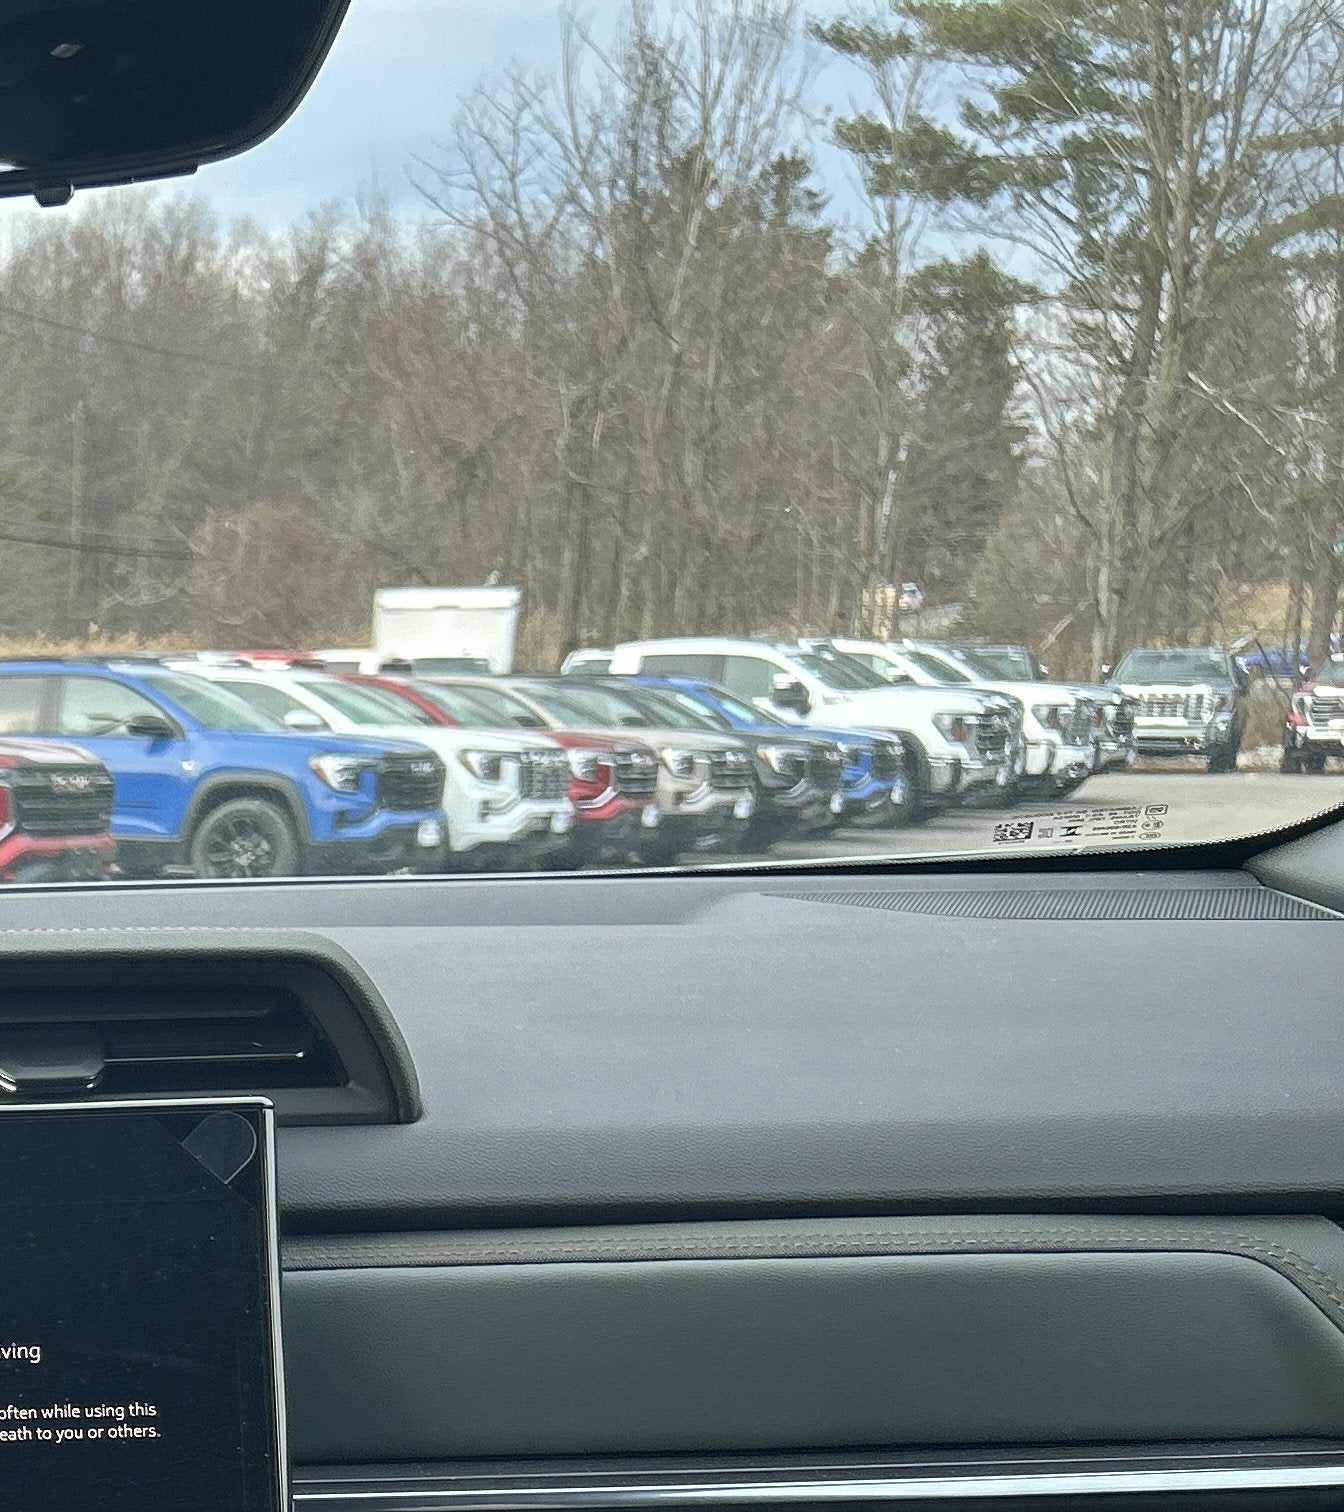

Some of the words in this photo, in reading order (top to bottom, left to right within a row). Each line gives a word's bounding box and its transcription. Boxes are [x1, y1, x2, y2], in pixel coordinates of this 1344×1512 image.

[41, 1403, 81, 1418] while
[85, 1403, 125, 1421] using
[128, 1402, 157, 1417] this
[36, 1426, 52, 1440] to
[55, 1426, 84, 1444] you
[87, 1427, 104, 1439] or
[108, 1423, 161, 1438] others.
